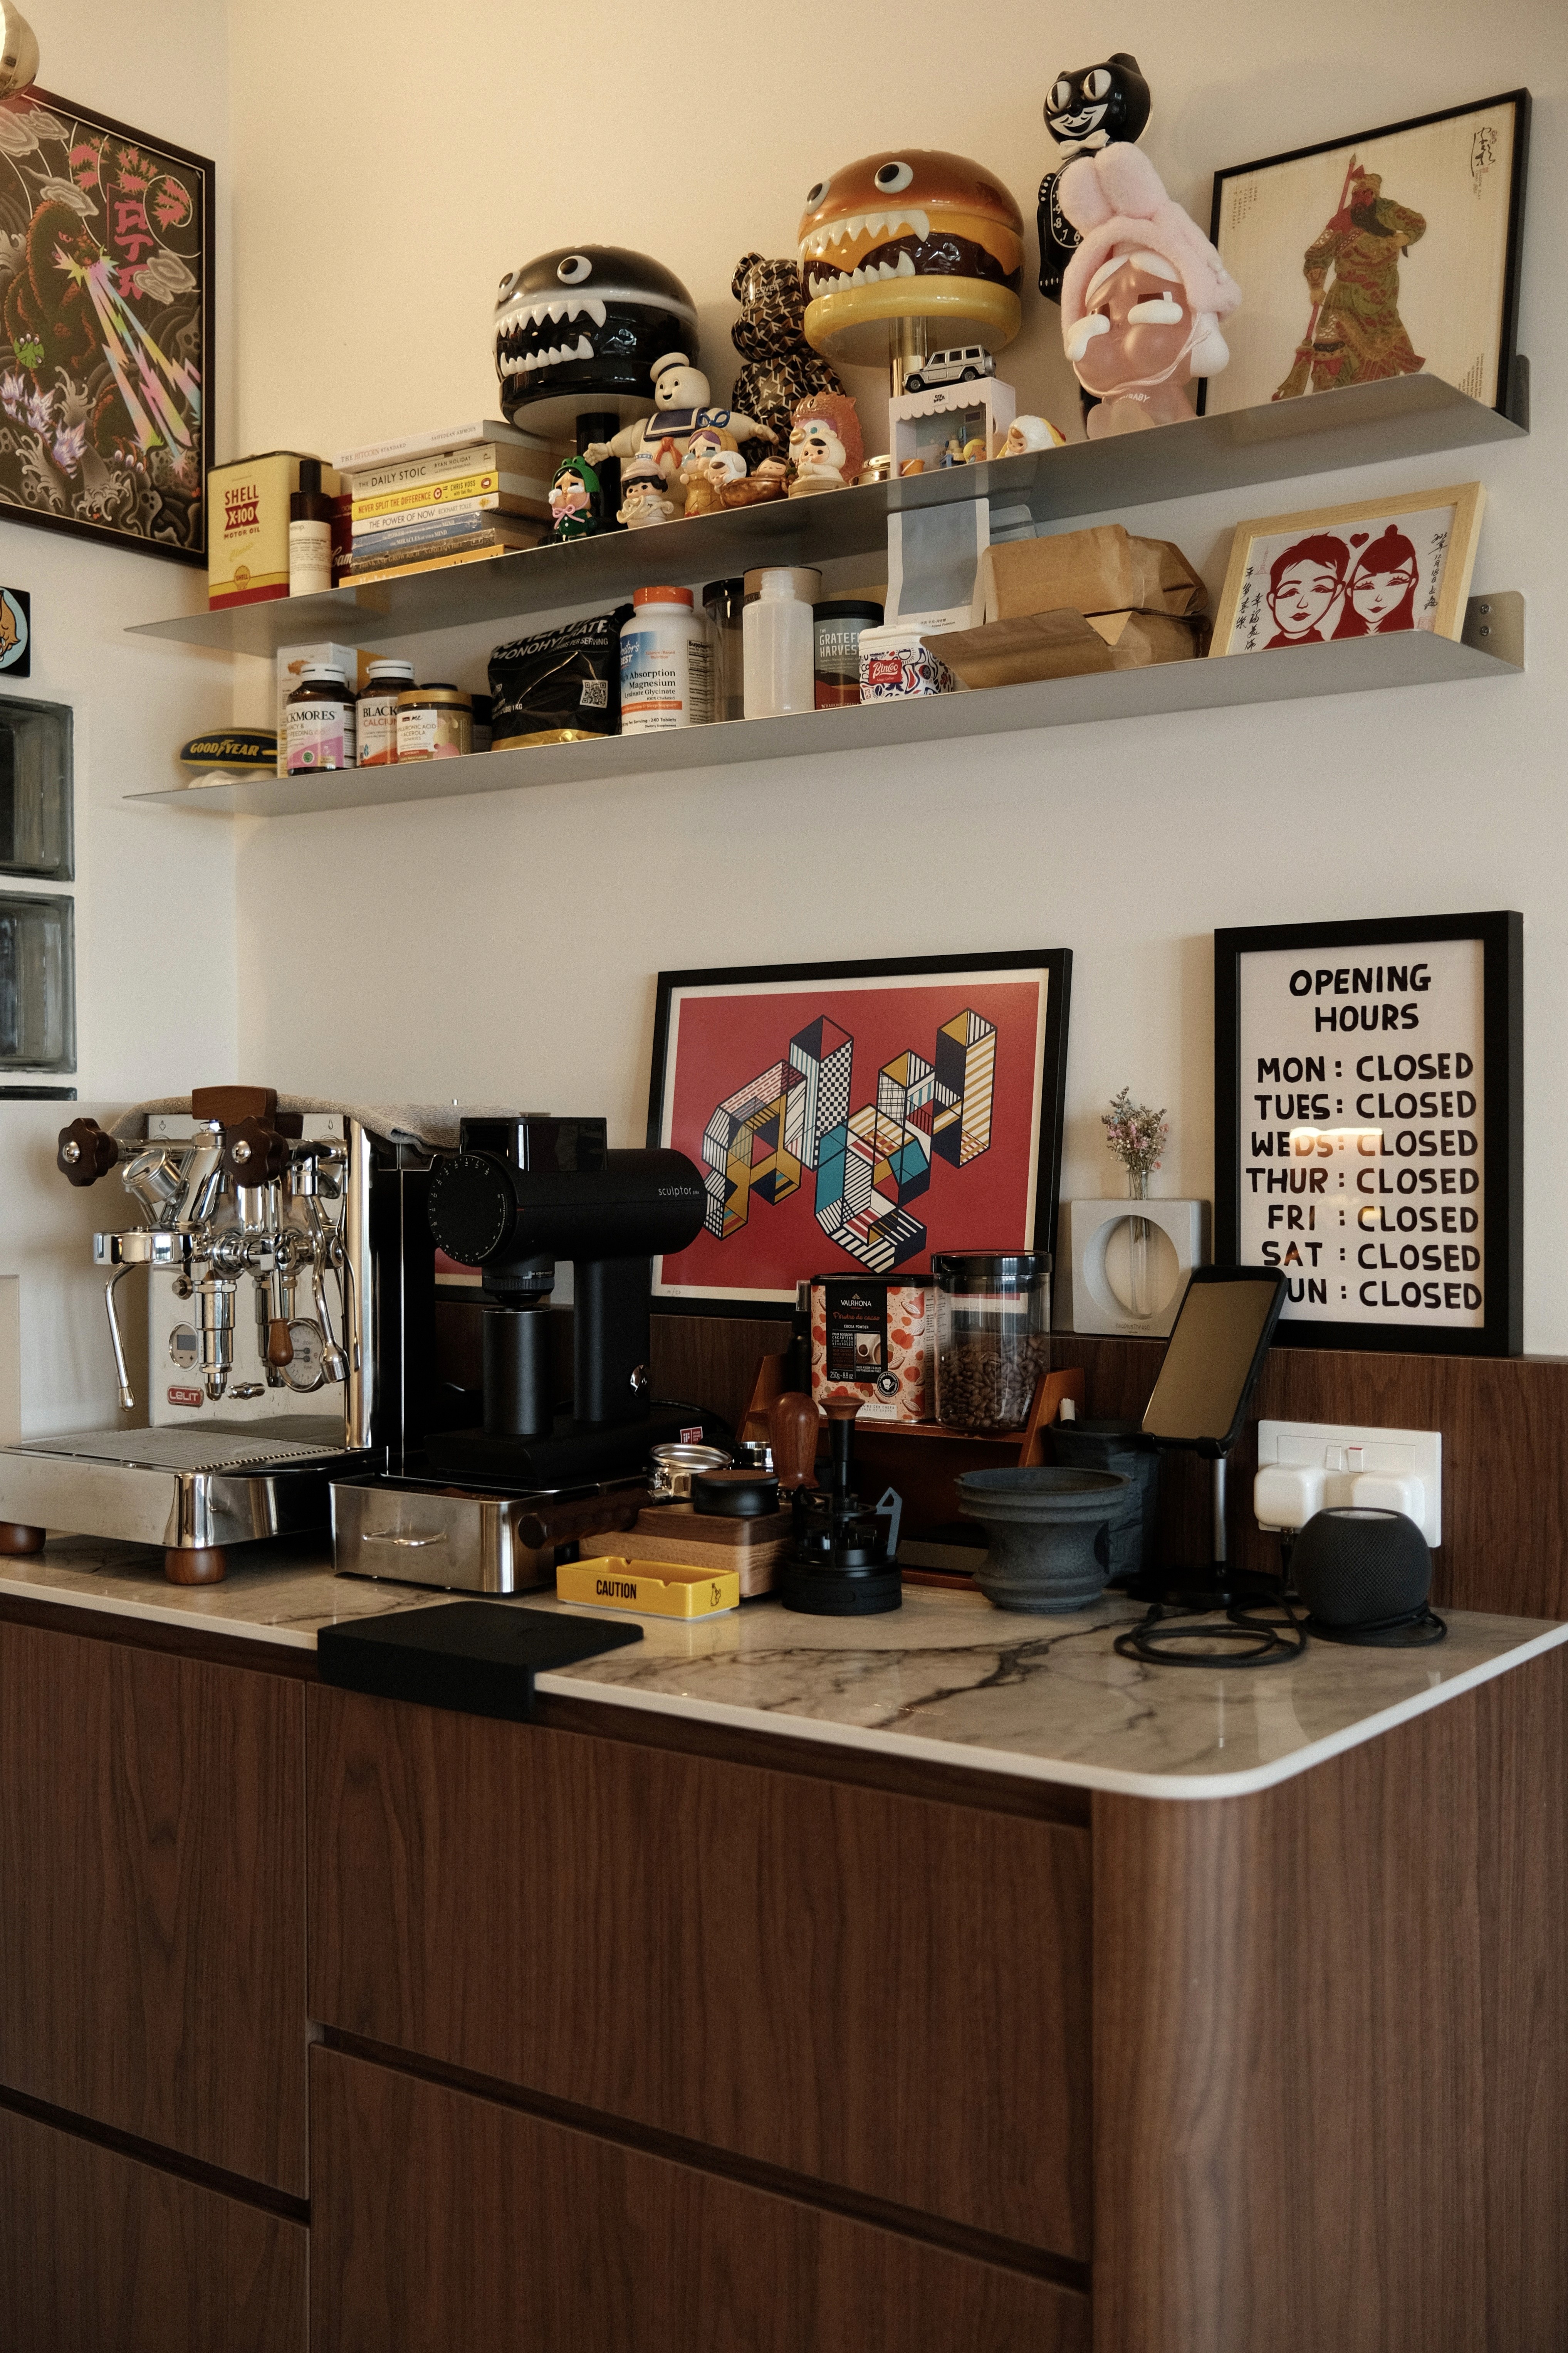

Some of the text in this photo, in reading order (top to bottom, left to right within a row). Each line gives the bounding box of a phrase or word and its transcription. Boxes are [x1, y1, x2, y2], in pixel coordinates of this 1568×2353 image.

[1056, 217, 1062, 229] 8
[1063, 229, 1068, 240] 7
[1074, 230, 1081, 242] 6
[341, 454, 354, 463] THE
[354, 448, 379, 460] BITCOIN
[380, 443, 406, 454] STANDARD
[371, 472, 396, 487] DAILY
[399, 466, 426, 481] STOIC
[448, 455, 471, 465] HOLIDAY
[225, 484, 259, 506] SHELL
[358, 504, 374, 514] NEVER
[375, 501, 389, 511] SPLIT
[390, 499, 400, 508] THE
[401, 491, 431, 506] DIFFERENCE
[450, 482, 463, 491] CHRIS
[464, 479, 476, 488] VOSS
[228, 506, 255, 526] X-100
[369, 502, 472, 529] THE POWER OF NOW ECKHART TOLLE
[224, 530, 247, 540] MOTOR
[396, 536, 421, 545] MIRACLES
[434, 529, 448, 538] MIND
[389, 554, 405, 563] GROW
[406, 551, 420, 560] RICH
[569, 637, 608, 647] PER SERVING
[820, 645, 860, 657] HARVES
[629, 679, 676, 690] Magnesium
[630, 669, 676, 680] Absorption
[625, 690, 644, 699] Lysinate
[1289, 963, 1431, 996] OPENING
[1315, 1003, 1419, 1033] HOURS
[1356, 1052, 1474, 1082] CLOSED
[1356, 1090, 1477, 1120] CLOSED
[1356, 1129, 1478, 1158] CLOSED
[658, 1185, 692, 1197] sculptor
[1356, 1168, 1479, 1195] CLOSED
[1358, 1206, 1479, 1233] CLOSED
[1358, 1243, 1481, 1272] CLOSED
[1287, 1278, 1482, 1310] UN CLOSED
[830, 1371, 840, 1380] 250g
[596, 1579, 637, 1600] CAUTION
